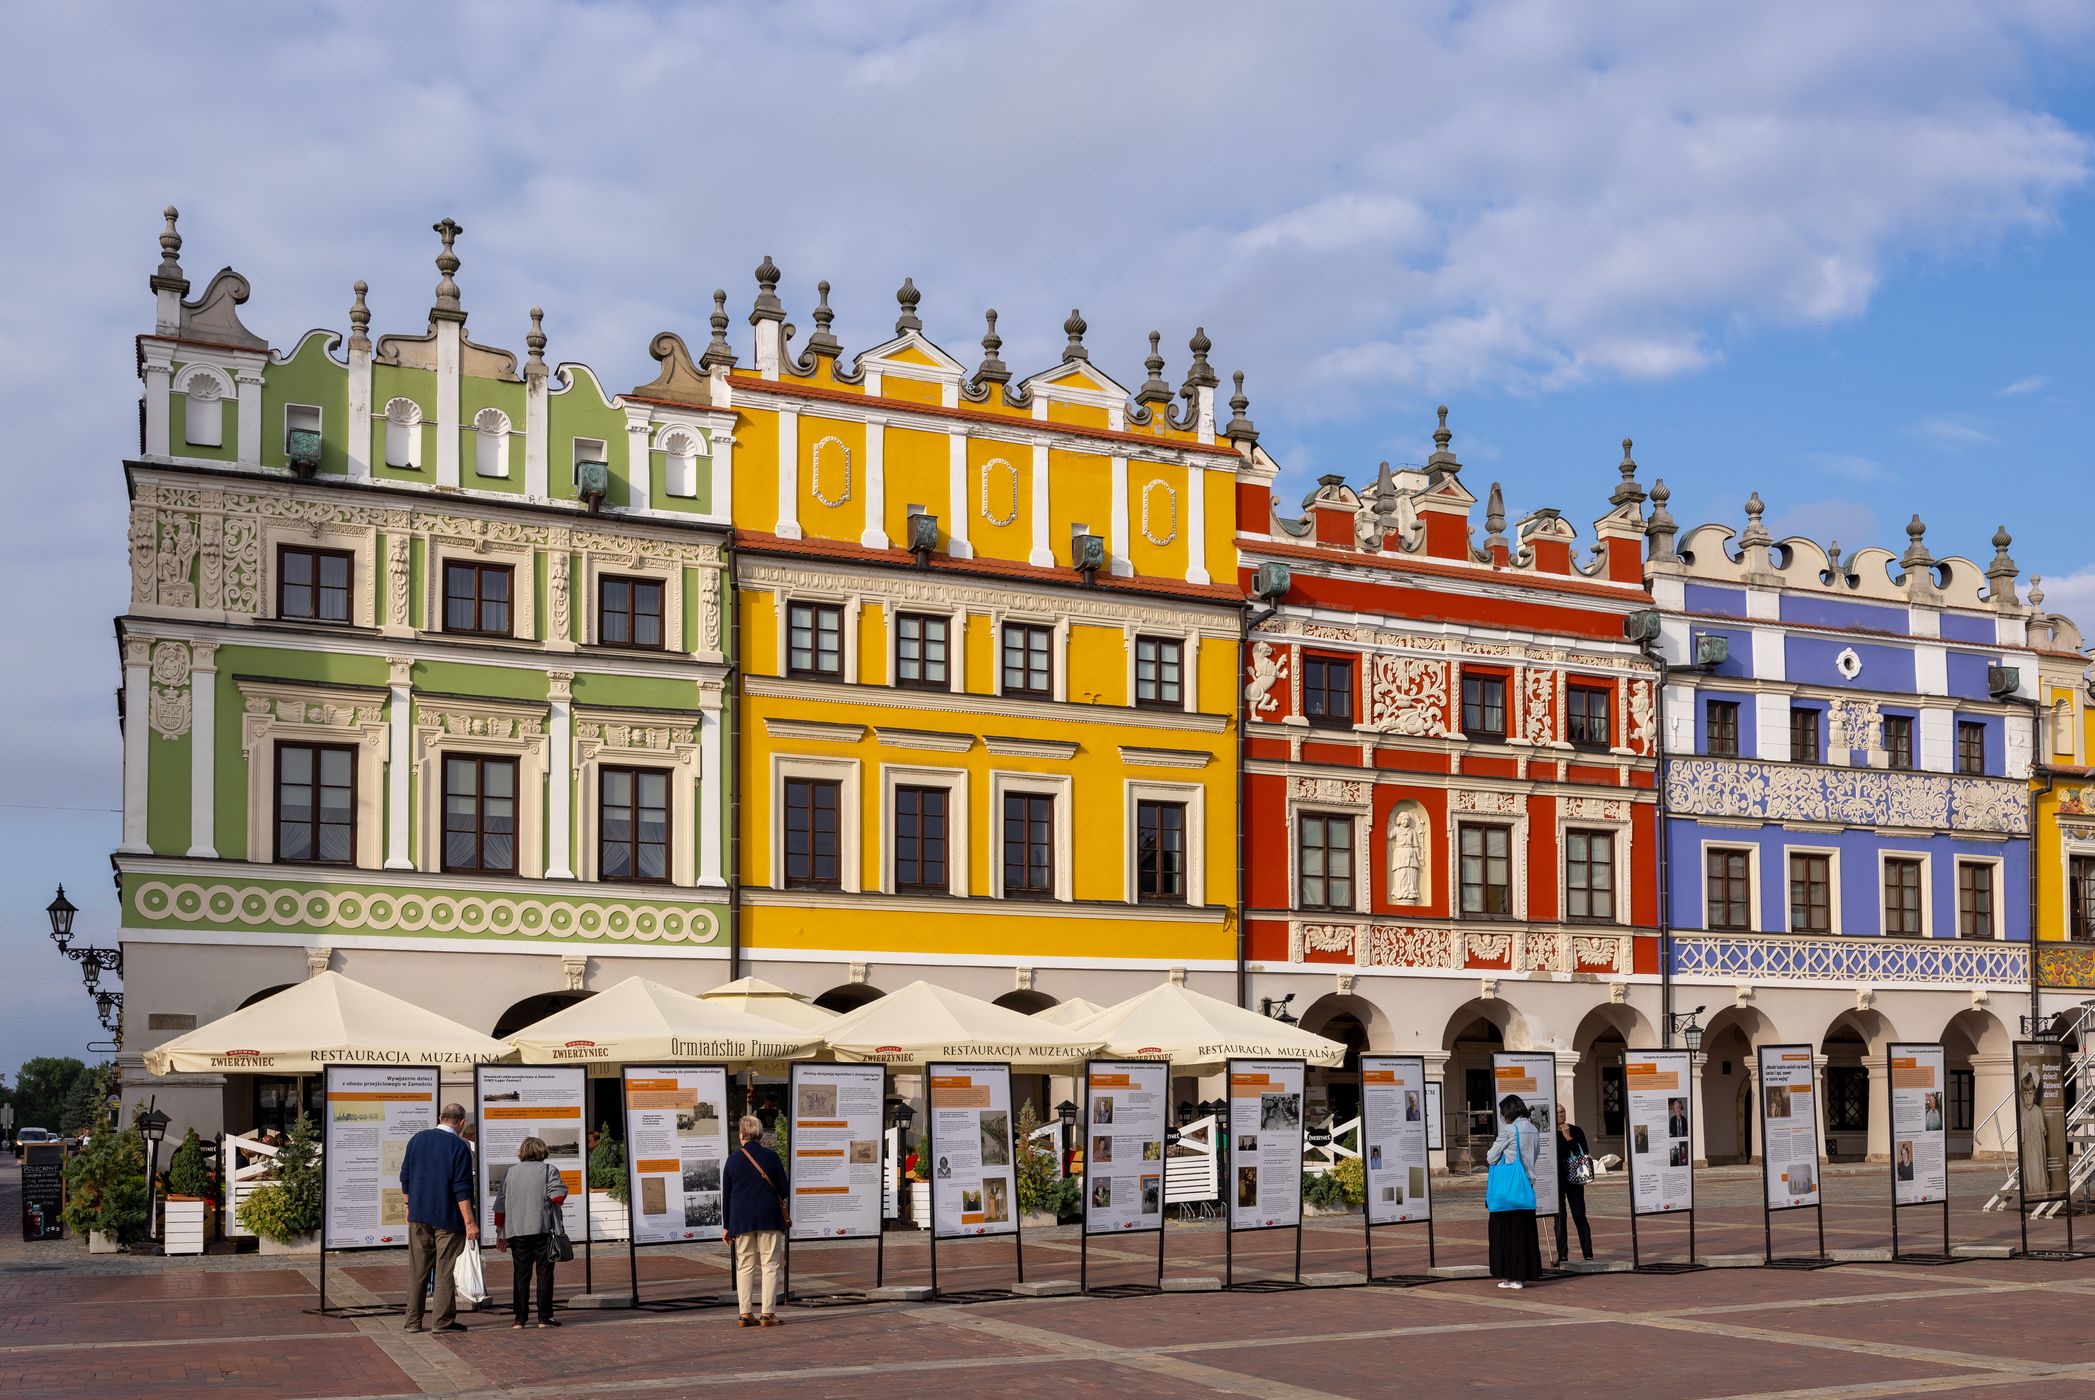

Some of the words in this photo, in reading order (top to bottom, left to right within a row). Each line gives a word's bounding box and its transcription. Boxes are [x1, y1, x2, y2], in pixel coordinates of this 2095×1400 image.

[552, 1047, 609, 1059] ZWIERZYNIEC
[671, 1037, 745, 1057] Ormiańskie
[943, 1045, 1021, 1057] RESTAURACJA
[1029, 1046, 1092, 1057] MUZEALNA
[1198, 1044, 1271, 1056] RESTAURACJA
[1277, 1047, 1336, 1059] MUZEALNA
[210, 1056, 275, 1067] ZWIERZYNIEC
[310, 1050, 411, 1064] RESTAURACJA
[420, 1052, 501, 1064] MUZEALNA
[862, 1053, 914, 1062] ZWIERZYNIEC
[2042, 1063, 2061, 1071] Ratować
[2043, 1081, 2062, 1089] Ratować
